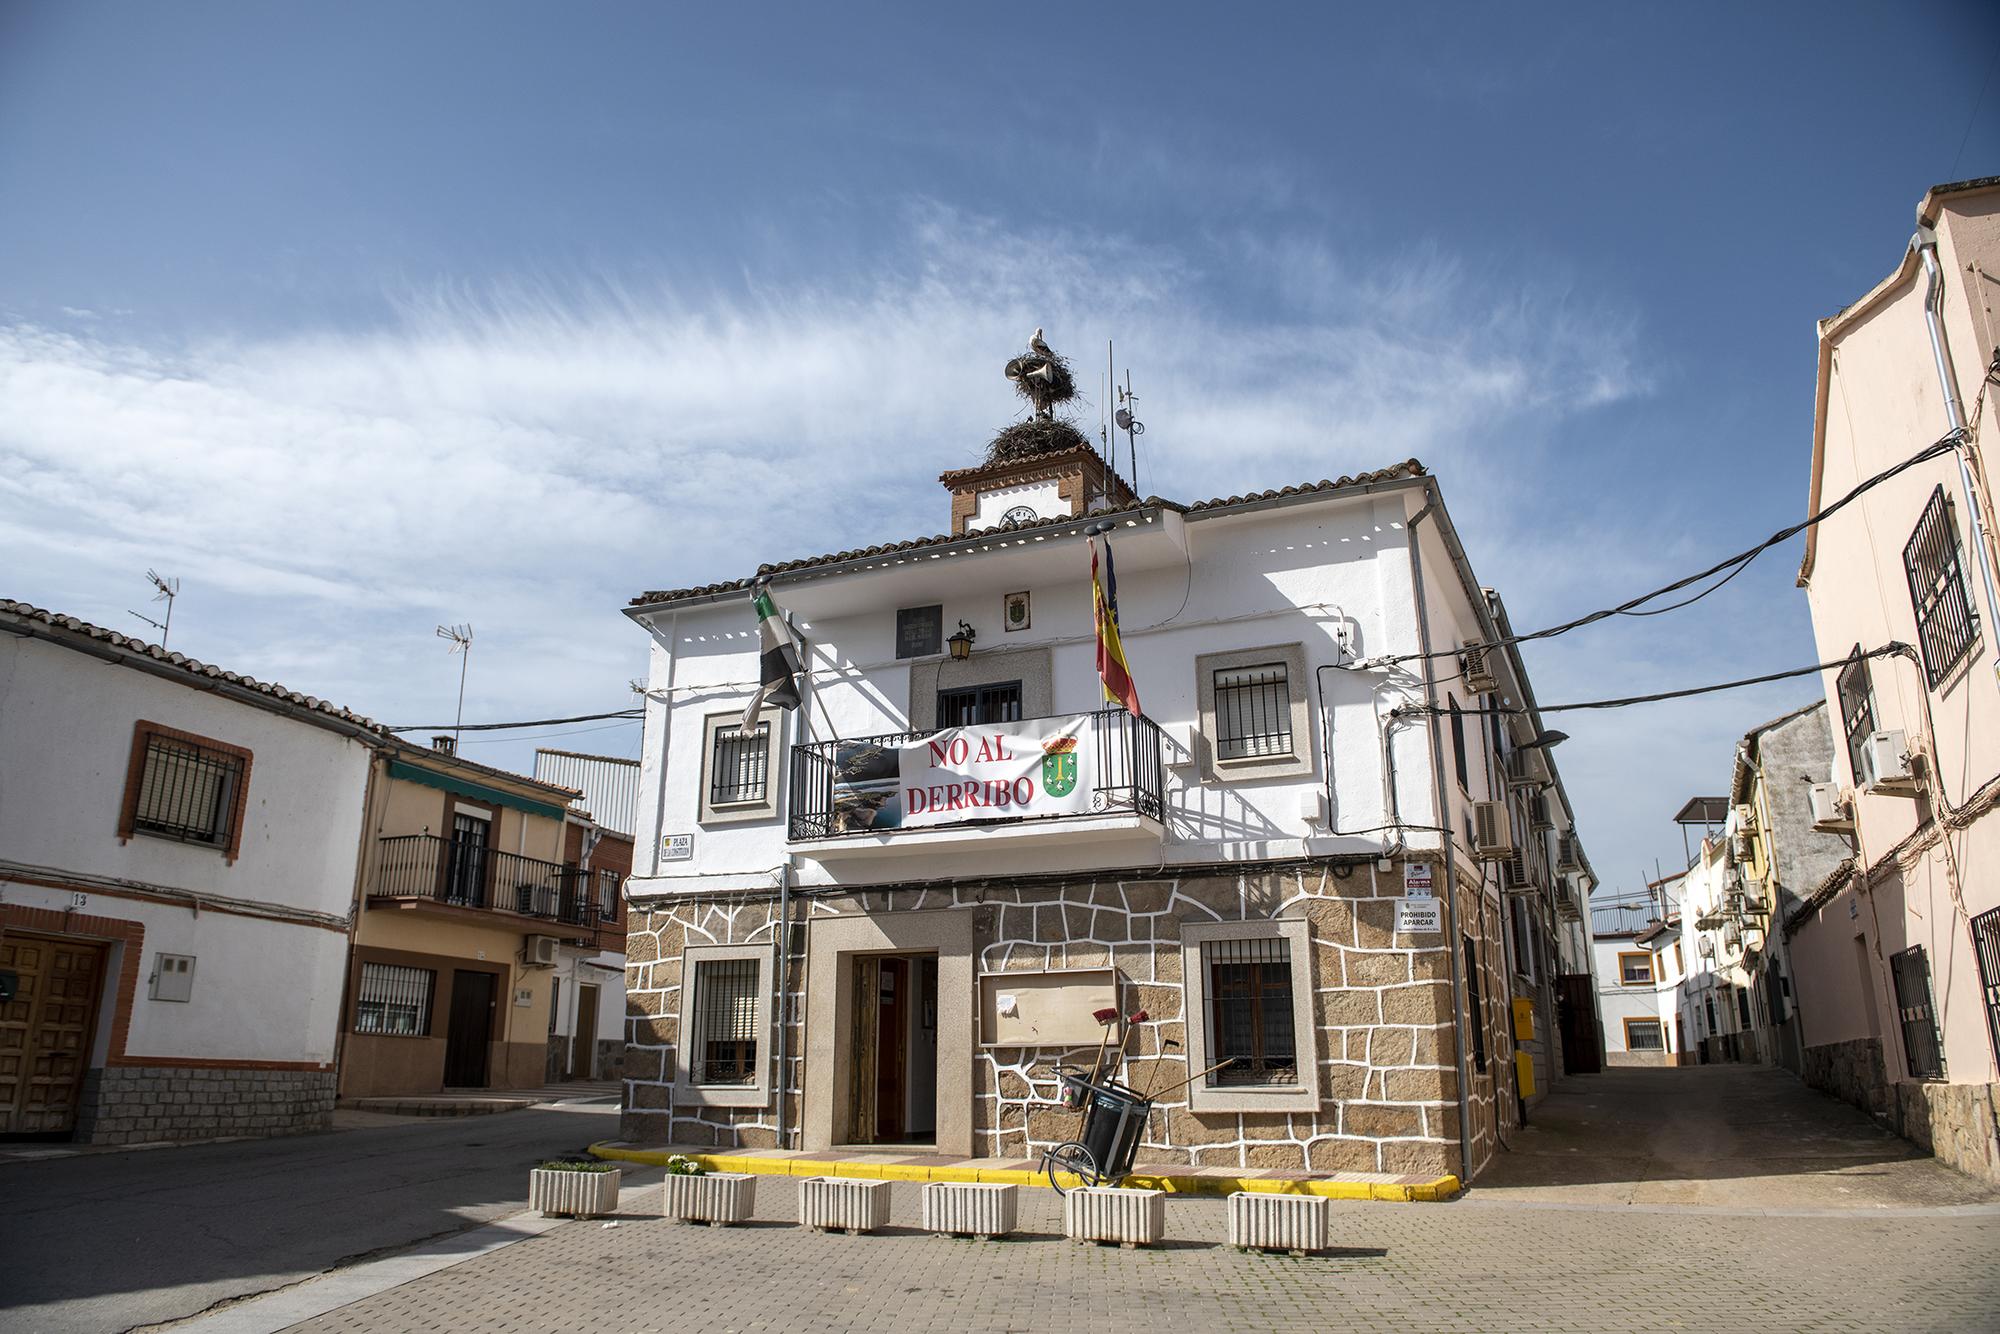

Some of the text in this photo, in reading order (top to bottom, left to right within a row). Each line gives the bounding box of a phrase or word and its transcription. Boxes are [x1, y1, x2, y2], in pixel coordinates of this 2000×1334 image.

[928, 734, 1013, 768] NO AL
[907, 776, 1034, 815] DERRIBO
[673, 837, 688, 847] PLAZA
[74, 893, 87, 906] 13
[1400, 911, 1437, 919] PROHIBIDO
[1403, 918, 1434, 926] APARCAR
